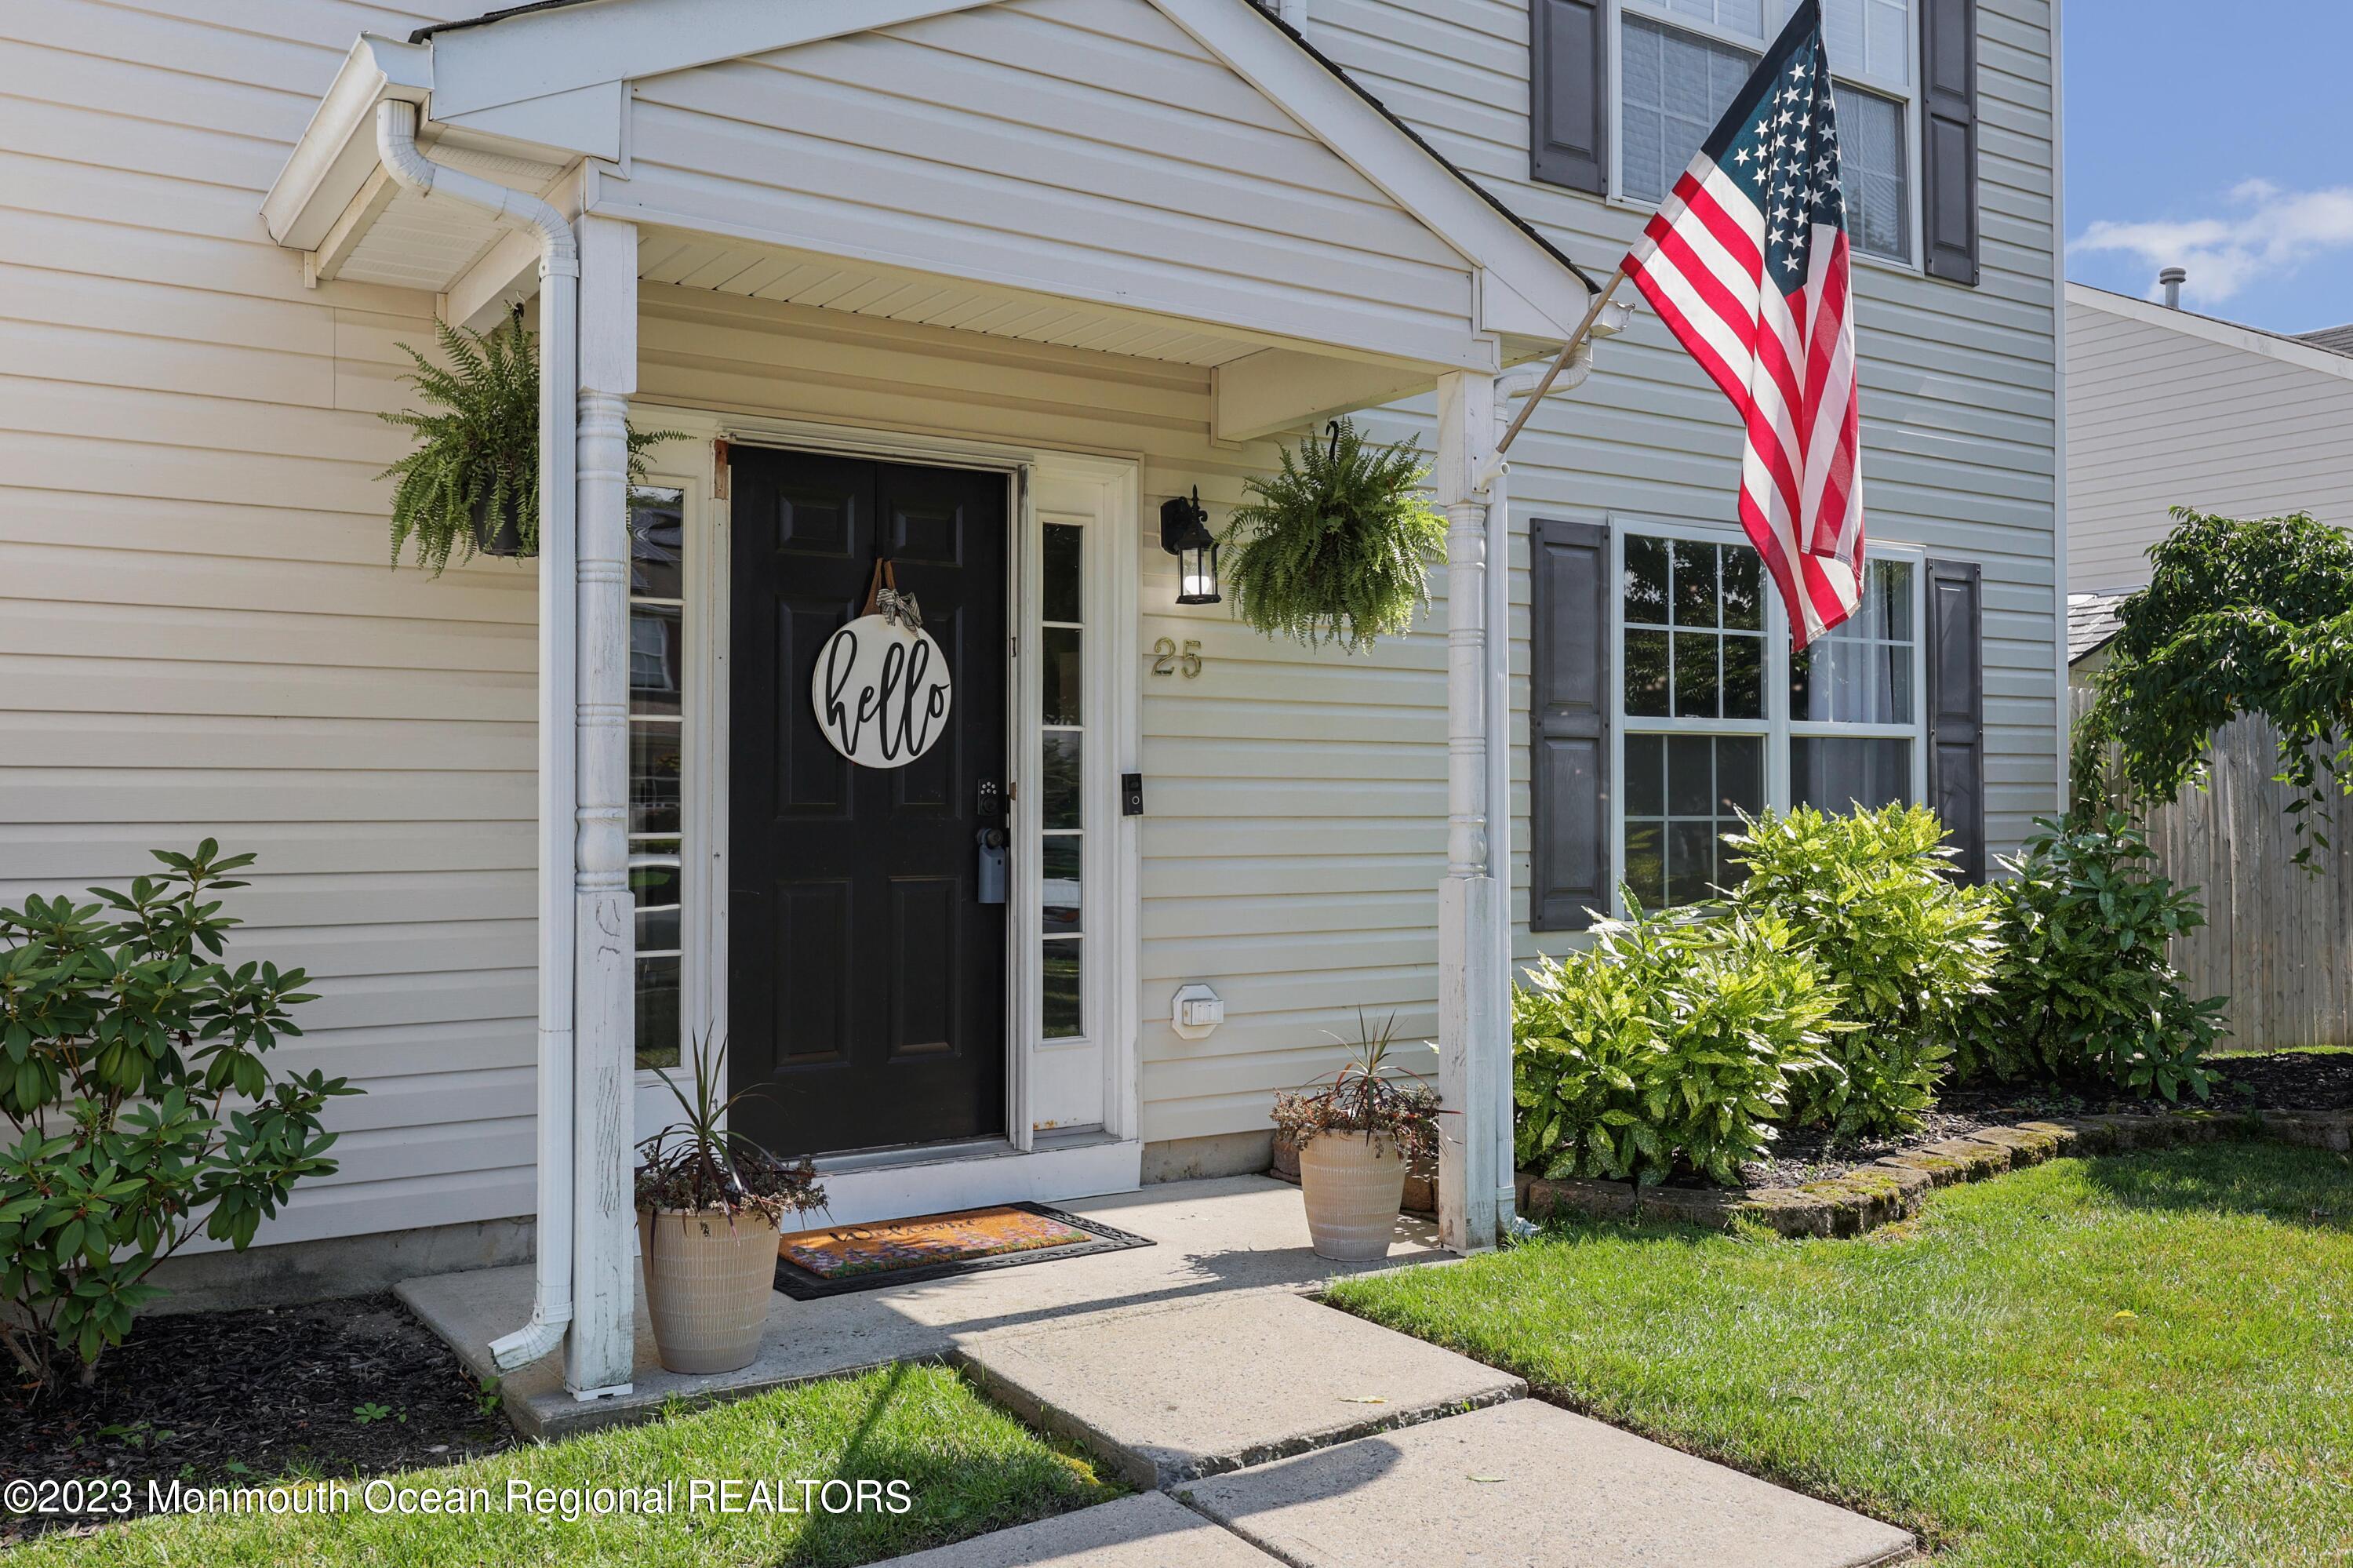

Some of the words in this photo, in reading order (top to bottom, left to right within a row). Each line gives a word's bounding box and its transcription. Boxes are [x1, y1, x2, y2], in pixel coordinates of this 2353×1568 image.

[1151, 636, 1202, 678] 25
[826, 630, 951, 760] hello
[828, 1219, 976, 1242] Welcome
